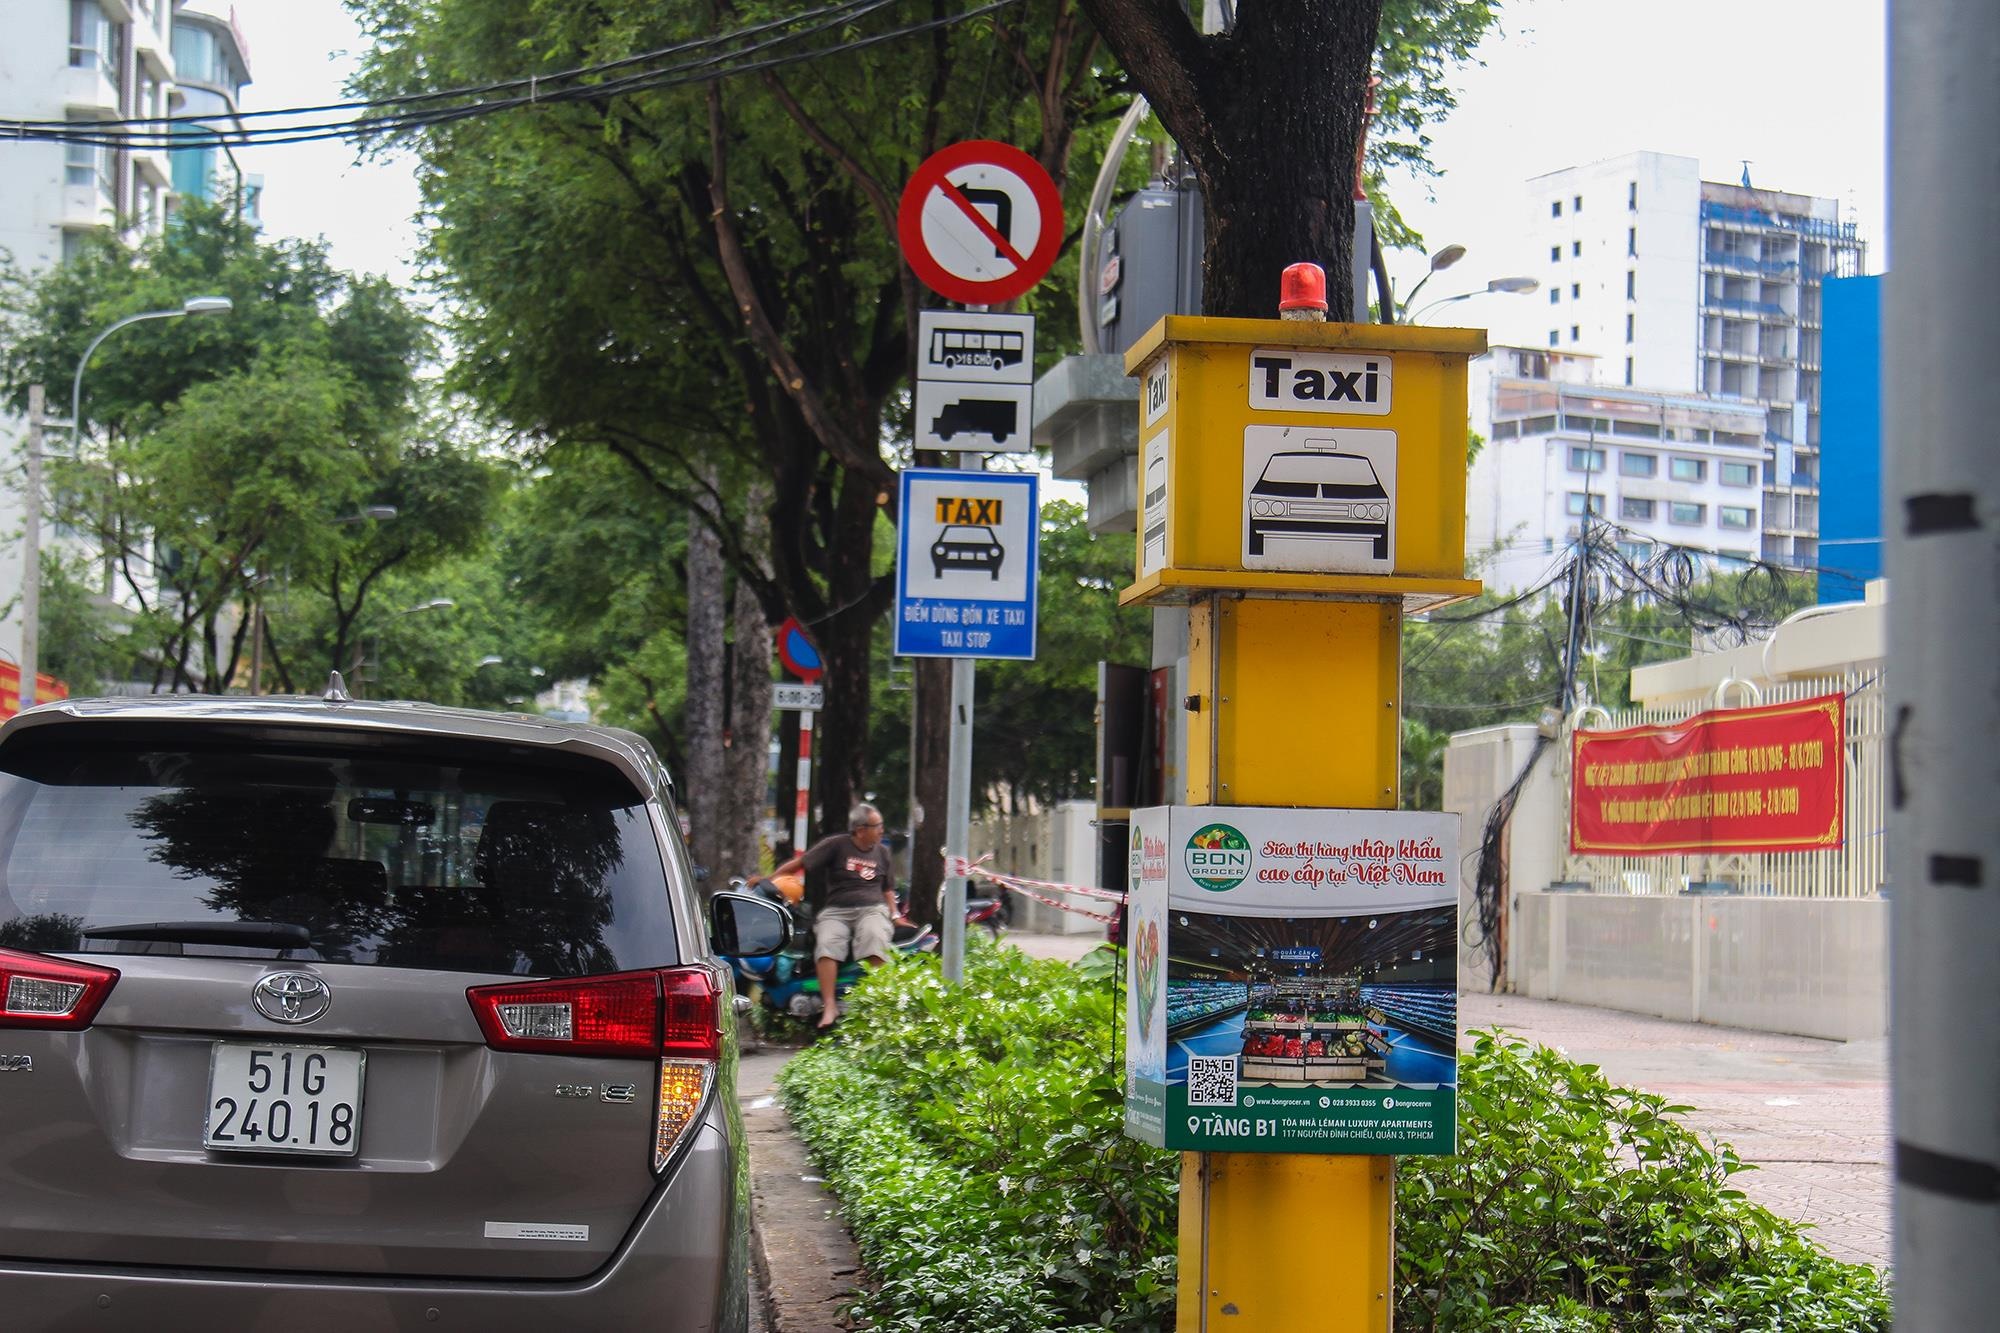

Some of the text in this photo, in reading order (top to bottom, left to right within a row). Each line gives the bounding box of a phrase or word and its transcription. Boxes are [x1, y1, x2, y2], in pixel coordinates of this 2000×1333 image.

[1147, 362, 1167, 415] Taxi
[1254, 356, 1379, 403] Taxi
[936, 497, 1002, 526] TAXI
[986, 608, 1000, 625] XE
[1004, 608, 1026, 626] TAXI
[941, 631, 992, 649] TAXI STOP
[1192, 852, 1245, 866] BON
[1262, 836, 1443, 864] Siêu thị hàng nhập khẩu
[1192, 868, 1244, 876] GROCER
[1258, 857, 1447, 887] cao cấp tại Việt Nam
[249, 1050, 326, 1096] 51G
[1256, 1097, 1311, 1107] www.bongrocer.vn
[1332, 1099, 1344, 1107] 028
[1395, 1099, 1432, 1108] bongrocervn
[212, 1097, 353, 1146] 240.18
[1202, 1112, 1276, 1137] TẦNG B1
[1282, 1117, 1297, 1127] TÒA
[1299, 1117, 1316, 1127] NHÀ
[1348, 1119, 1379, 1128] LUXURY
[1381, 1120, 1433, 1129] APARTMENTS
[1282, 1129, 1296, 1138] 117
[1330, 1128, 1349, 1139] ĐÌNH
[1398, 1131, 1406, 1140] 3,
[1407, 1131, 1434, 1140] TP.HCM
